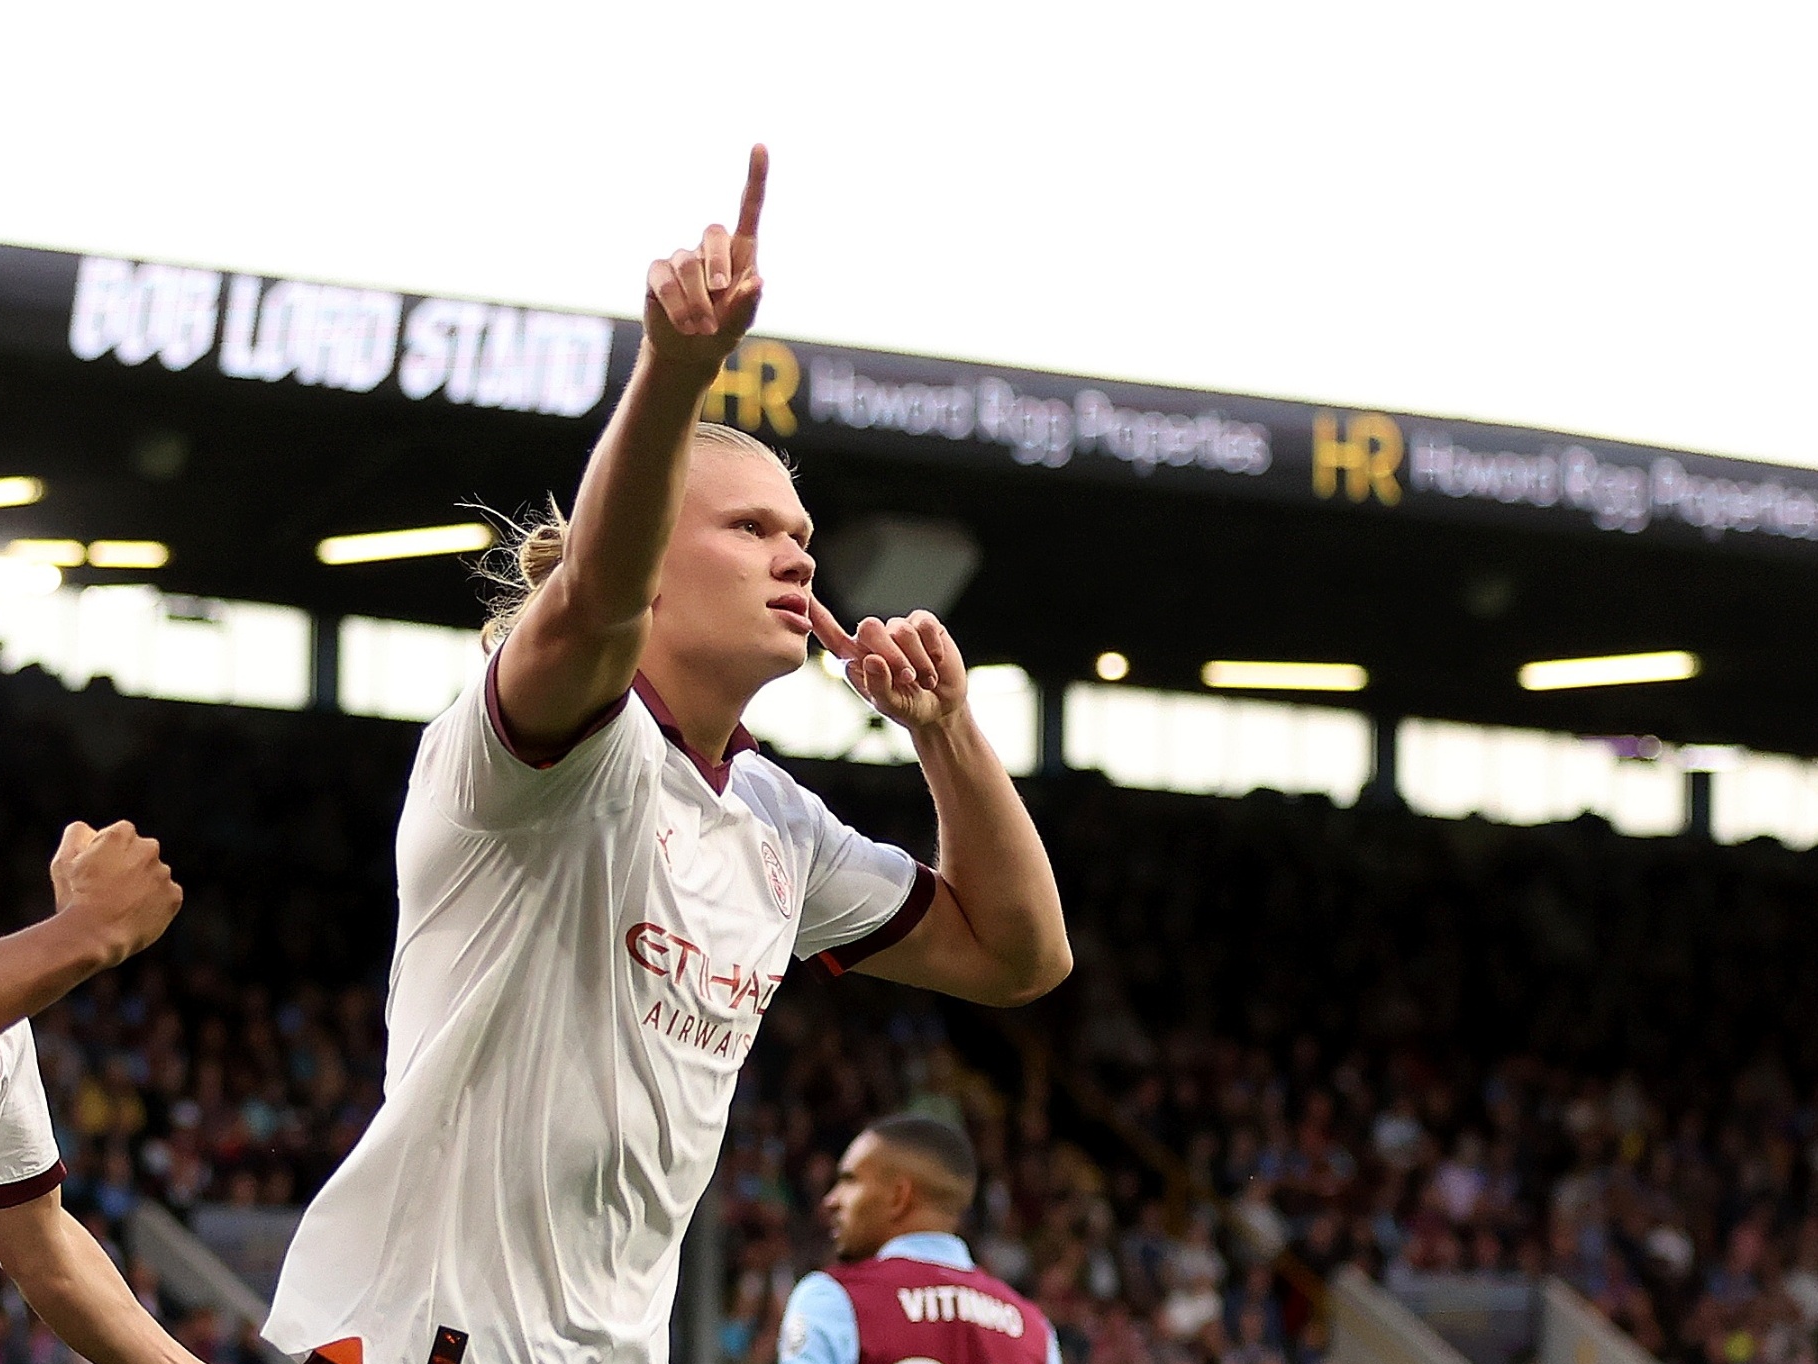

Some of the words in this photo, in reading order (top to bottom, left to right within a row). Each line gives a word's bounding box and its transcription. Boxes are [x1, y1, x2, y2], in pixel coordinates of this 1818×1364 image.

[68, 254, 220, 372] BOB
[218, 274, 403, 393] LORD
[395, 297, 615, 419] STAND
[809, 355, 978, 441] Howard
[978, 375, 1072, 468] Rigg
[1072, 389, 1274, 477] Properties
[1312, 408, 1405, 506] HR
[1410, 426, 1559, 508] Howard
[1561, 443, 1650, 534] Rigg
[896, 1285, 1025, 1339] VITINHO
